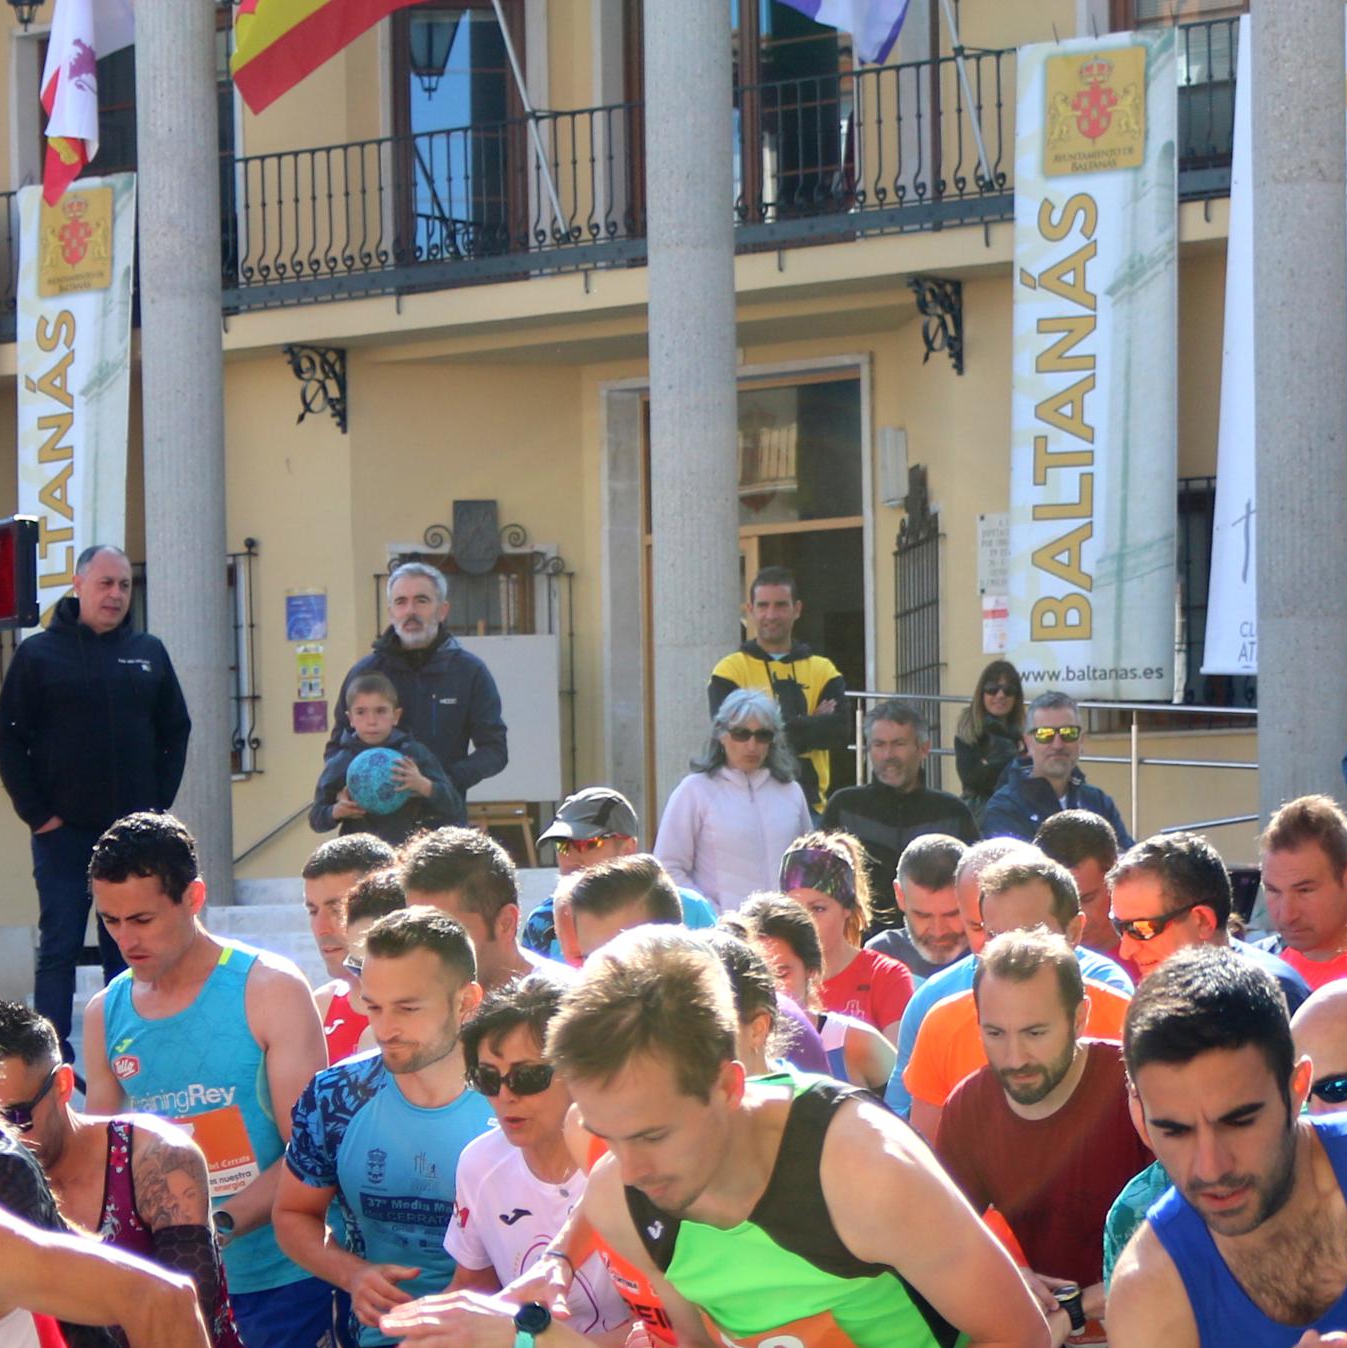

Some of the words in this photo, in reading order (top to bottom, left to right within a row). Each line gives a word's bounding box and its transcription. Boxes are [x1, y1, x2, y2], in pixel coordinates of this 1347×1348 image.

[25, 310, 76, 631] LTANÁS
[1019, 192, 1098, 642] BALTANÁS
[219, 1170, 252, 1184] nuestra
[391, 1200, 430, 1212] Media
